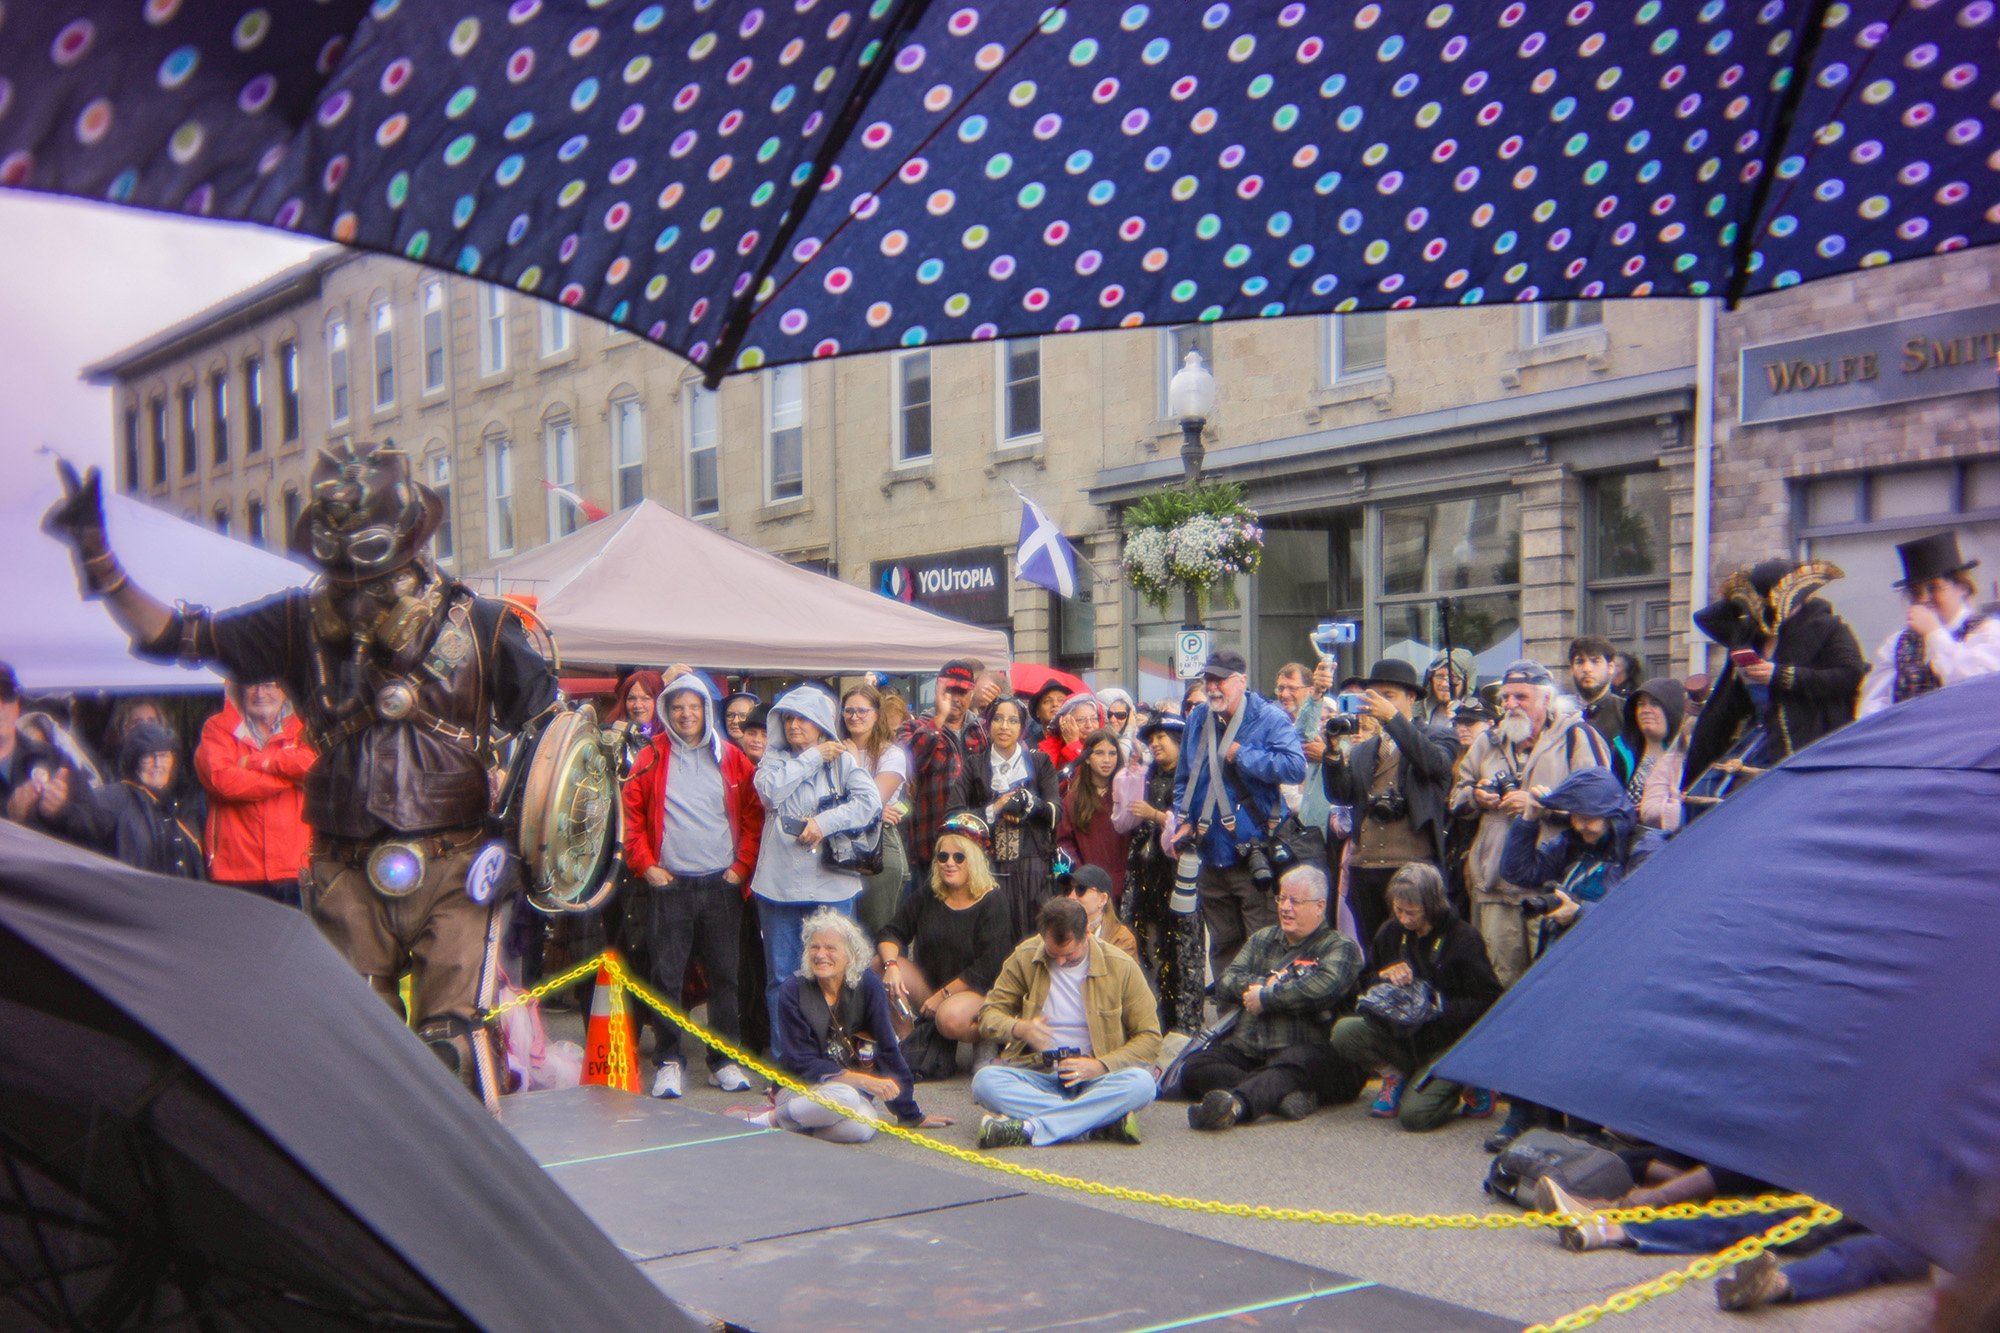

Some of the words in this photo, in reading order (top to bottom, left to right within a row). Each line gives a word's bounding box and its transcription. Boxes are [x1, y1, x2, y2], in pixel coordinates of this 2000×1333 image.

[1764, 352, 1879, 396] WOLFE
[919, 567, 994, 593] YOUTOPIA
[1187, 639, 1198, 650] P
